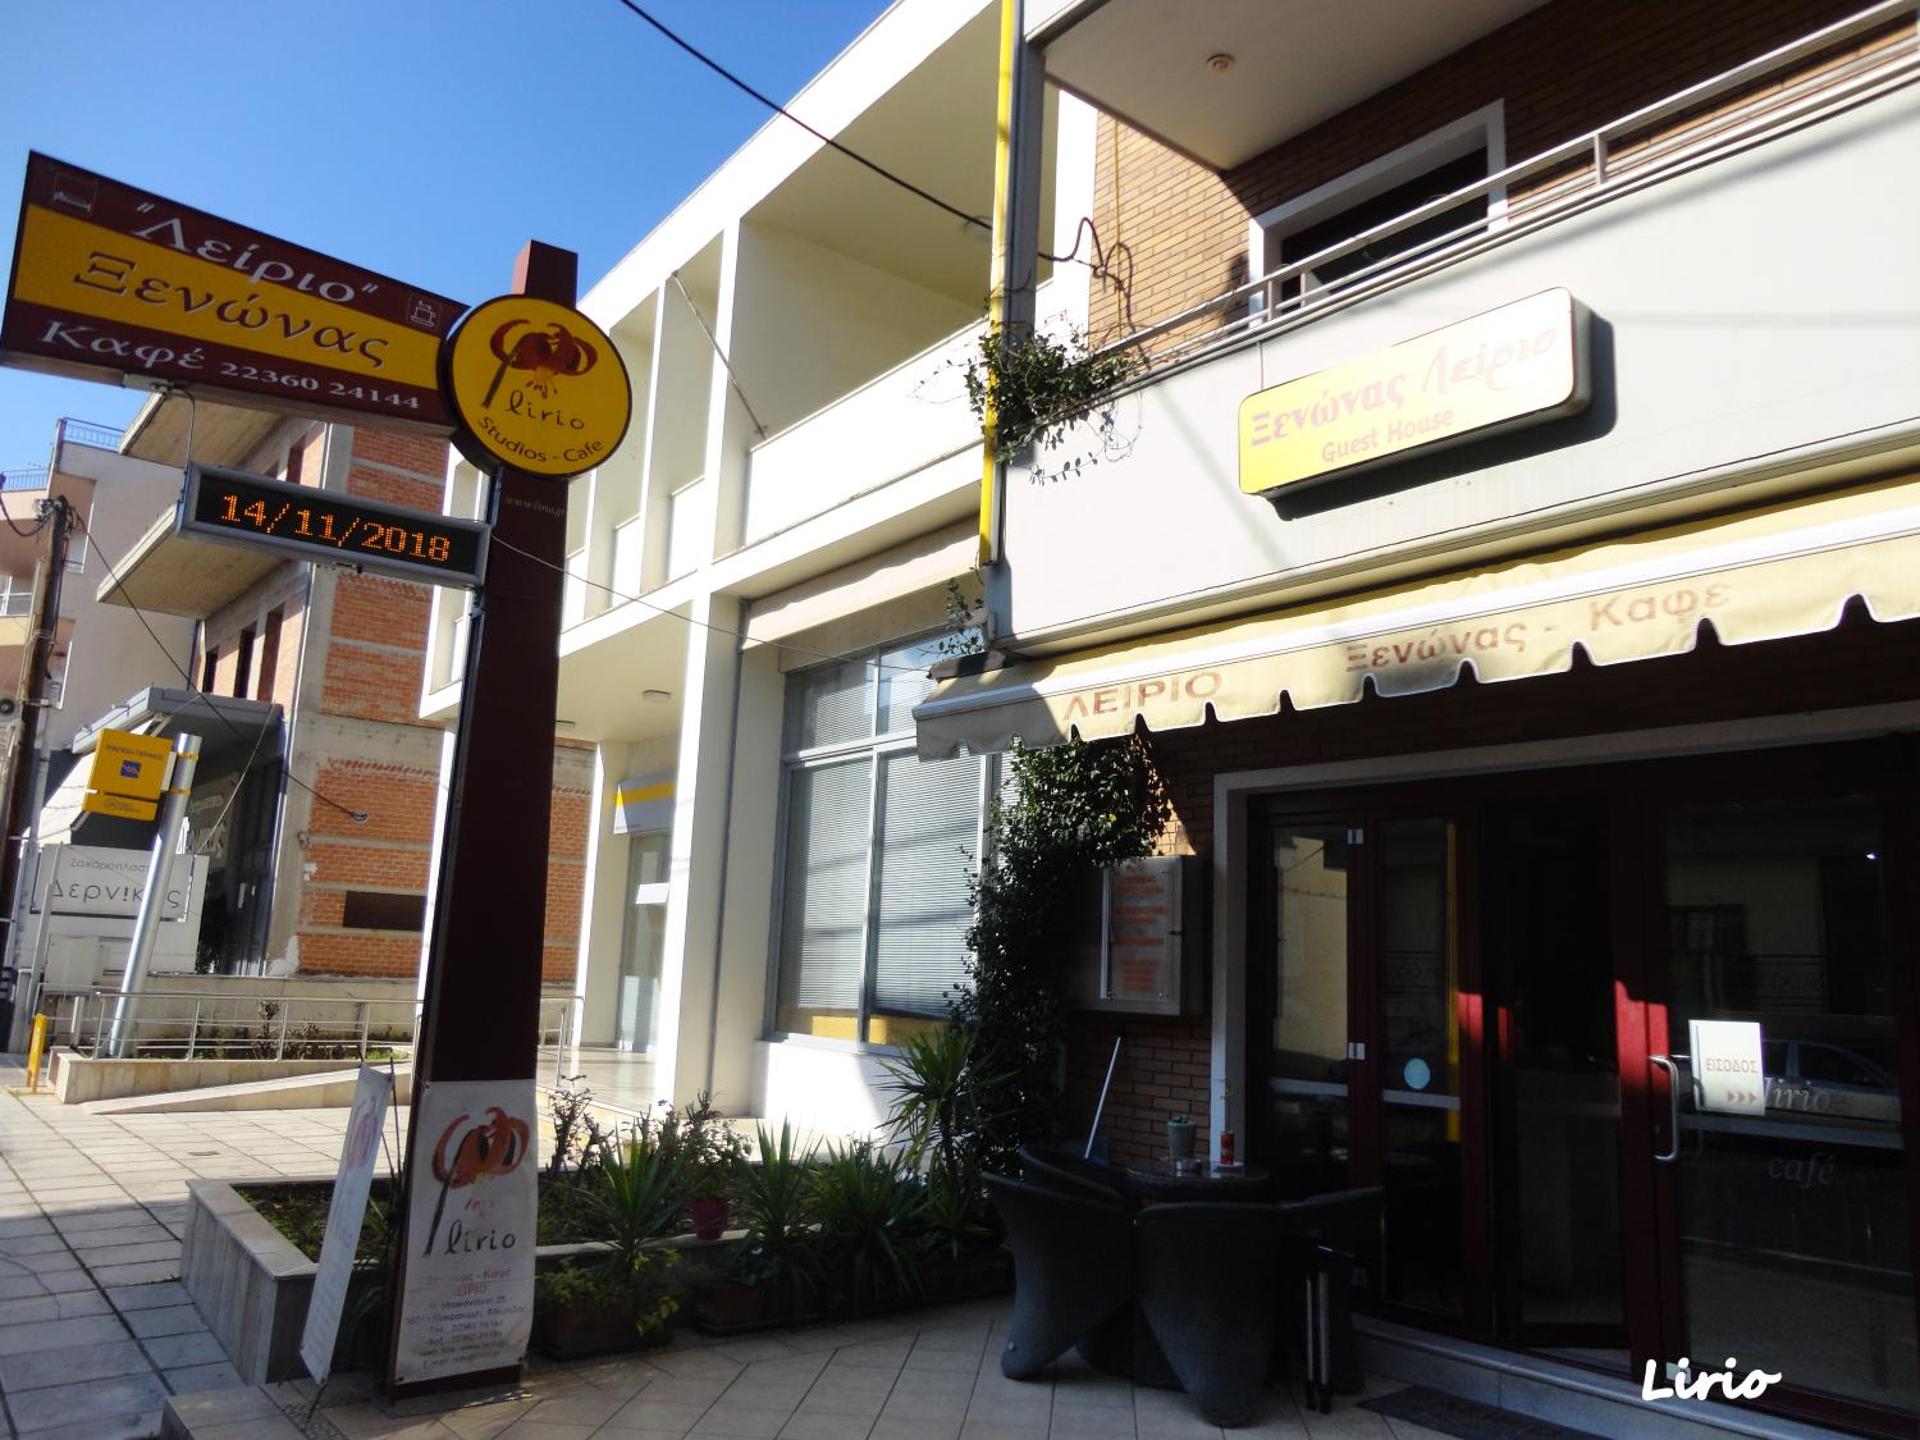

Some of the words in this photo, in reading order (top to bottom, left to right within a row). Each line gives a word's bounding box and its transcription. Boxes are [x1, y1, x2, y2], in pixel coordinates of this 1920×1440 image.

[73, 251, 390, 368] Ξενώνας
[39, 319, 206, 369] Καφέ
[220, 361, 321, 391] 22360
[328, 381, 419, 409] 24144
[505, 389, 585, 430] lirio
[1250, 373, 1408, 447] Ξενώνας
[479, 416, 547, 462] Studios
[563, 440, 603, 462] Cafe
[1321, 427, 1379, 464] Guest
[1386, 410, 1456, 446] House
[220, 494, 451, 562] 14/11/2018
[1344, 621, 1527, 674] Ξενώνας
[1062, 670, 1223, 721] ΛΕΙΡΙΟ
[1705, 1056, 1759, 1074] ΕΙΣΟΔΟΣ
[1768, 1152, 1837, 1188] café
[444, 1219, 517, 1255] lirio
